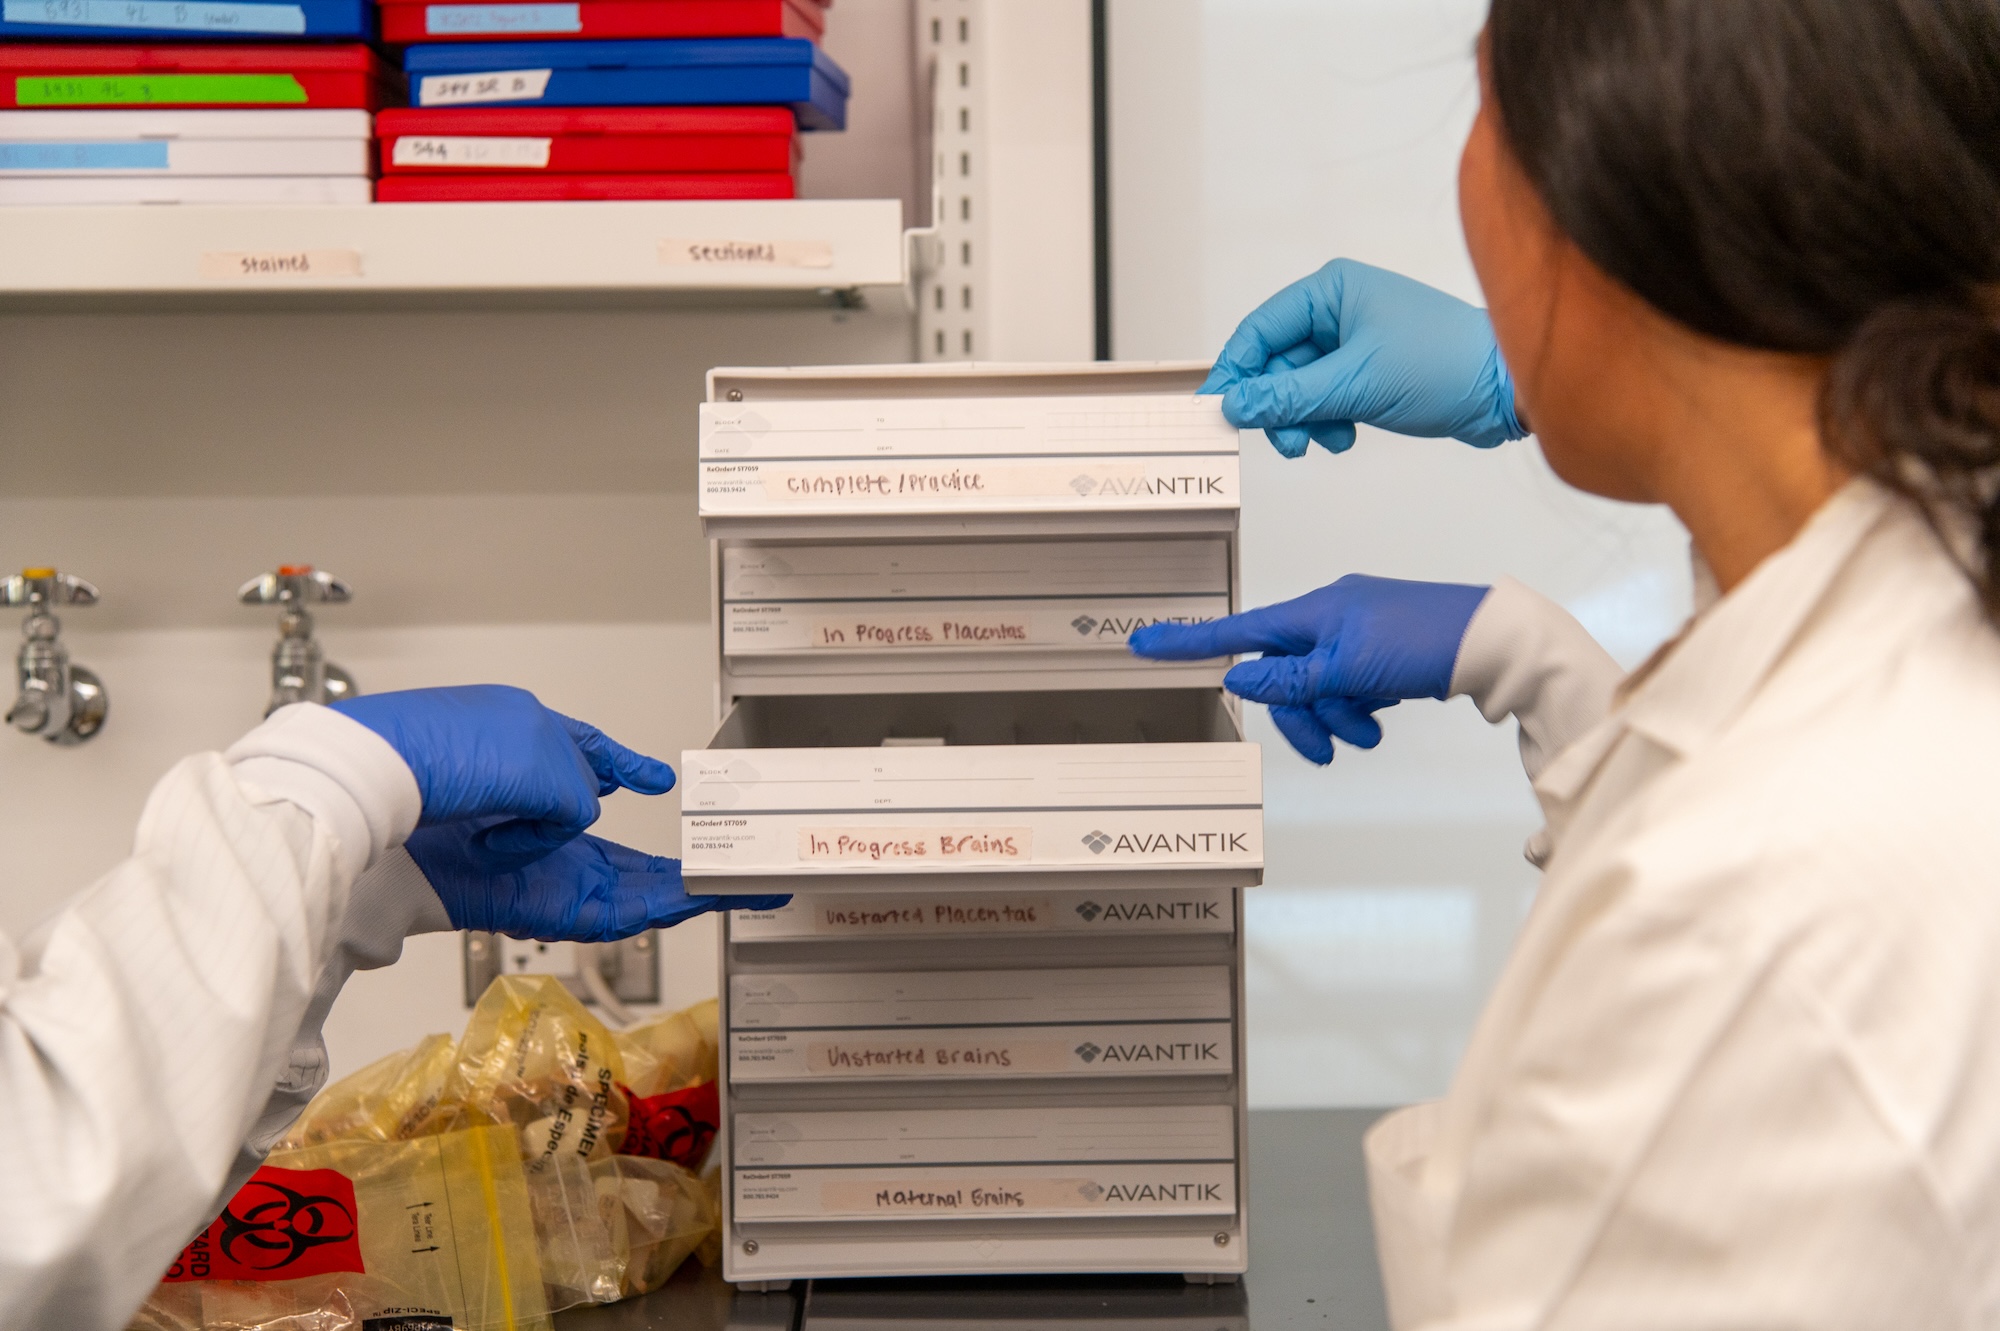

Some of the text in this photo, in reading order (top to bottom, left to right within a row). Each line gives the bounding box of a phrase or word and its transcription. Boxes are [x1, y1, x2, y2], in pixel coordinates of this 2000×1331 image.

[688, 241, 776, 262] sectioned
[241, 253, 310, 273] stained
[1098, 475, 1225, 496] AVANTIK
[823, 622, 1026, 645] In Progress Placentas
[811, 834, 1018, 860] In Progress Brains
[1113, 832, 1249, 854] AVANTIK
[826, 908, 924, 926] Unstarted
[1104, 902, 1220, 921] AVANTIK
[828, 1046, 1012, 1068] Unstarted Brains
[1102, 1043, 1219, 1062] AVANTIK
[876, 1189, 962, 1208] Maternal
[1105, 1184, 1222, 1202] AVANTIK
